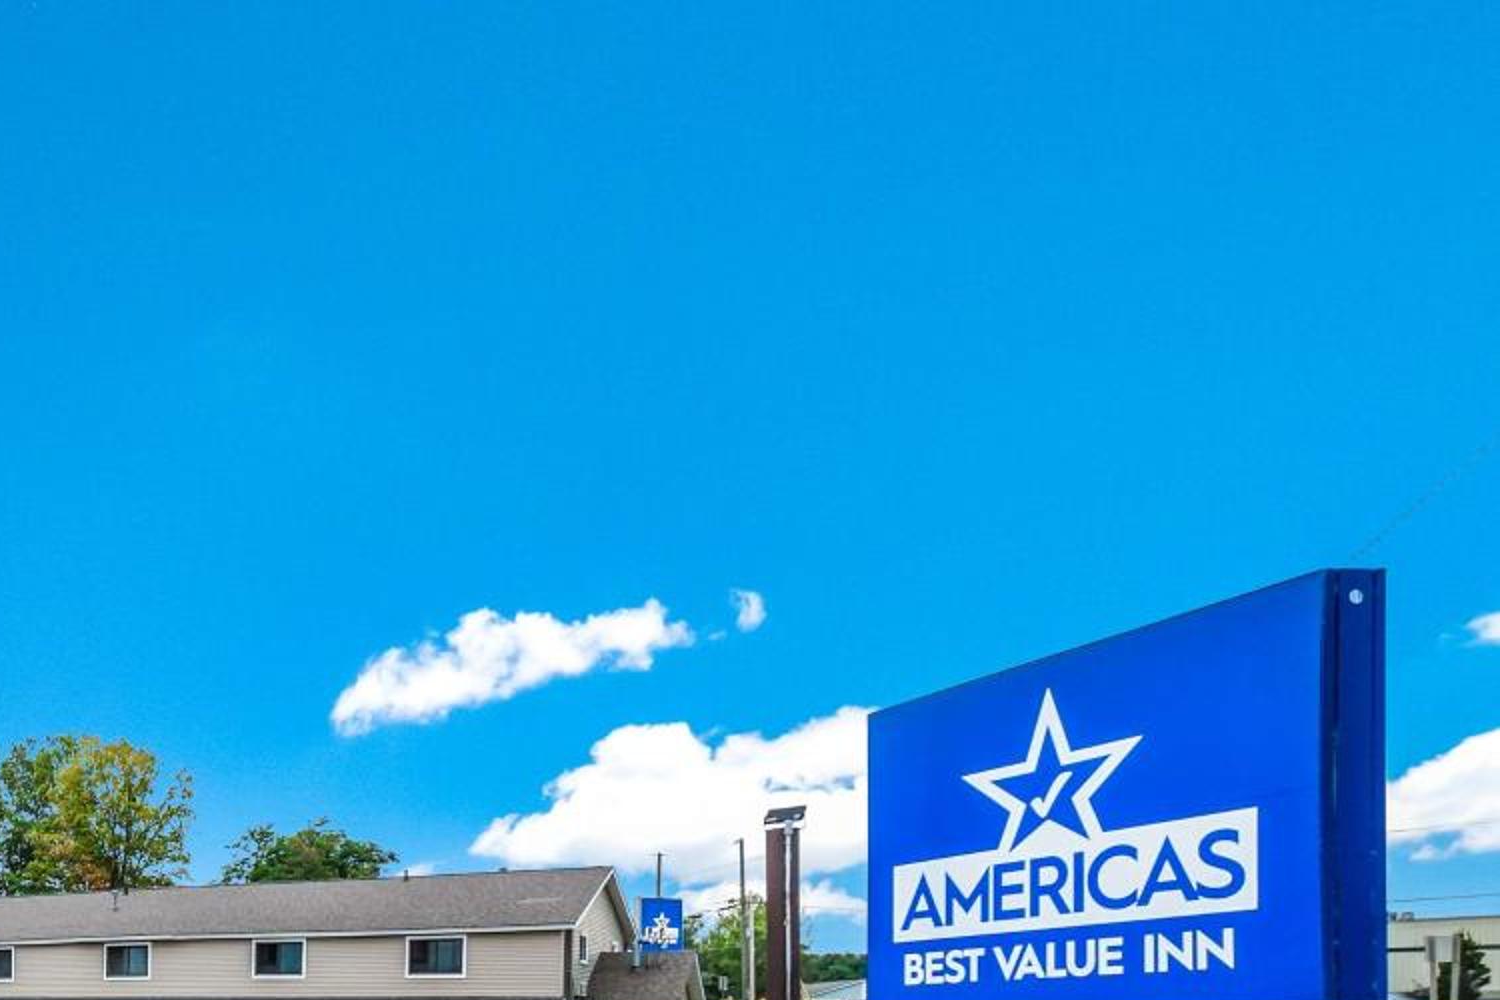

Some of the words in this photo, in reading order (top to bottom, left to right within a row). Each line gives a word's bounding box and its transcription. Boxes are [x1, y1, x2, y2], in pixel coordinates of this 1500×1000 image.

[901, 828, 1246, 931] AMERICAS
[903, 947, 985, 986] BEST
[993, 936, 1124, 980] VALUE
[1143, 927, 1235, 973] INN
